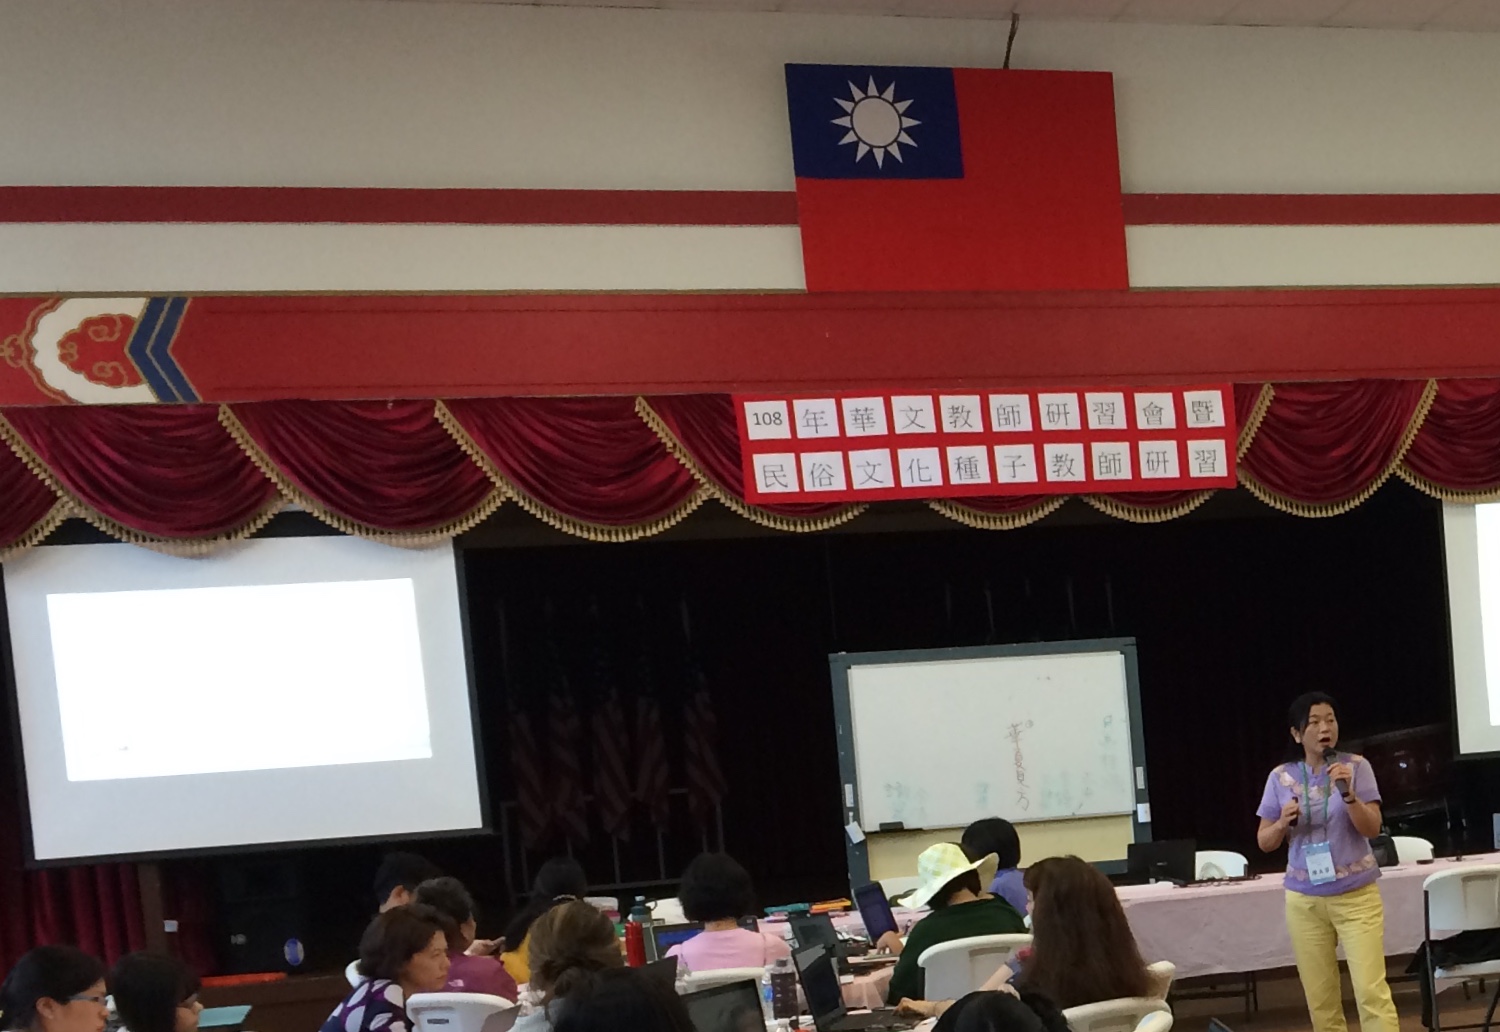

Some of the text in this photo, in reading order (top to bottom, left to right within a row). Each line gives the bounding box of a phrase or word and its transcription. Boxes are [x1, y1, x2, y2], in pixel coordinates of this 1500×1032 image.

[752, 400, 1216, 434] 108年華文教師研習會暨
[763, 448, 1216, 488] 民俗文化種子教師研習
